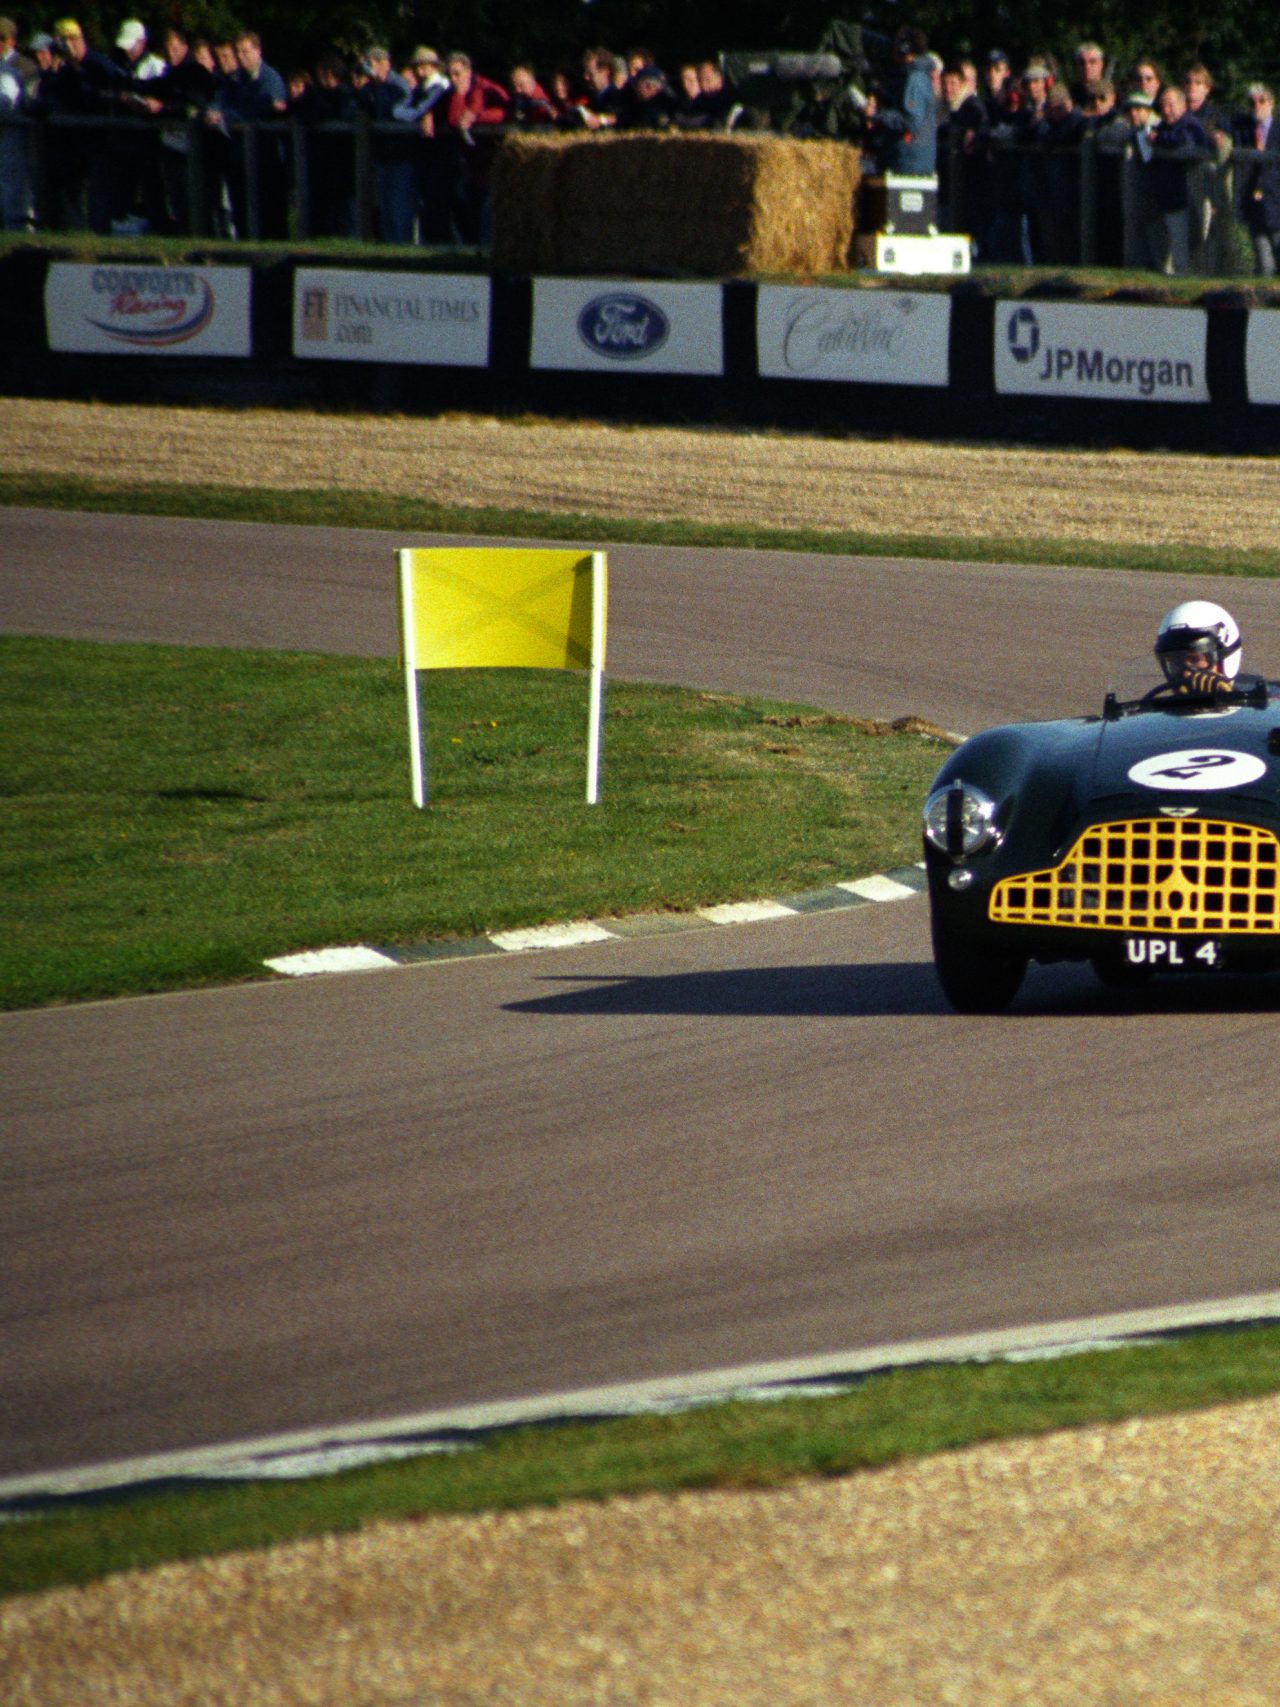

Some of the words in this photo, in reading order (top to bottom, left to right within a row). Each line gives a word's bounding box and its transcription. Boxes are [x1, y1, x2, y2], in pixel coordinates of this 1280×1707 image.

[429, 298, 481, 323] TIMES
[594, 302, 650, 345] Ford
[1039, 348, 1194, 395] JPMorgan
[1149, 754, 1237, 780] 2
[1127, 938, 1184, 964] UPL
[1195, 941, 1217, 965] 4
